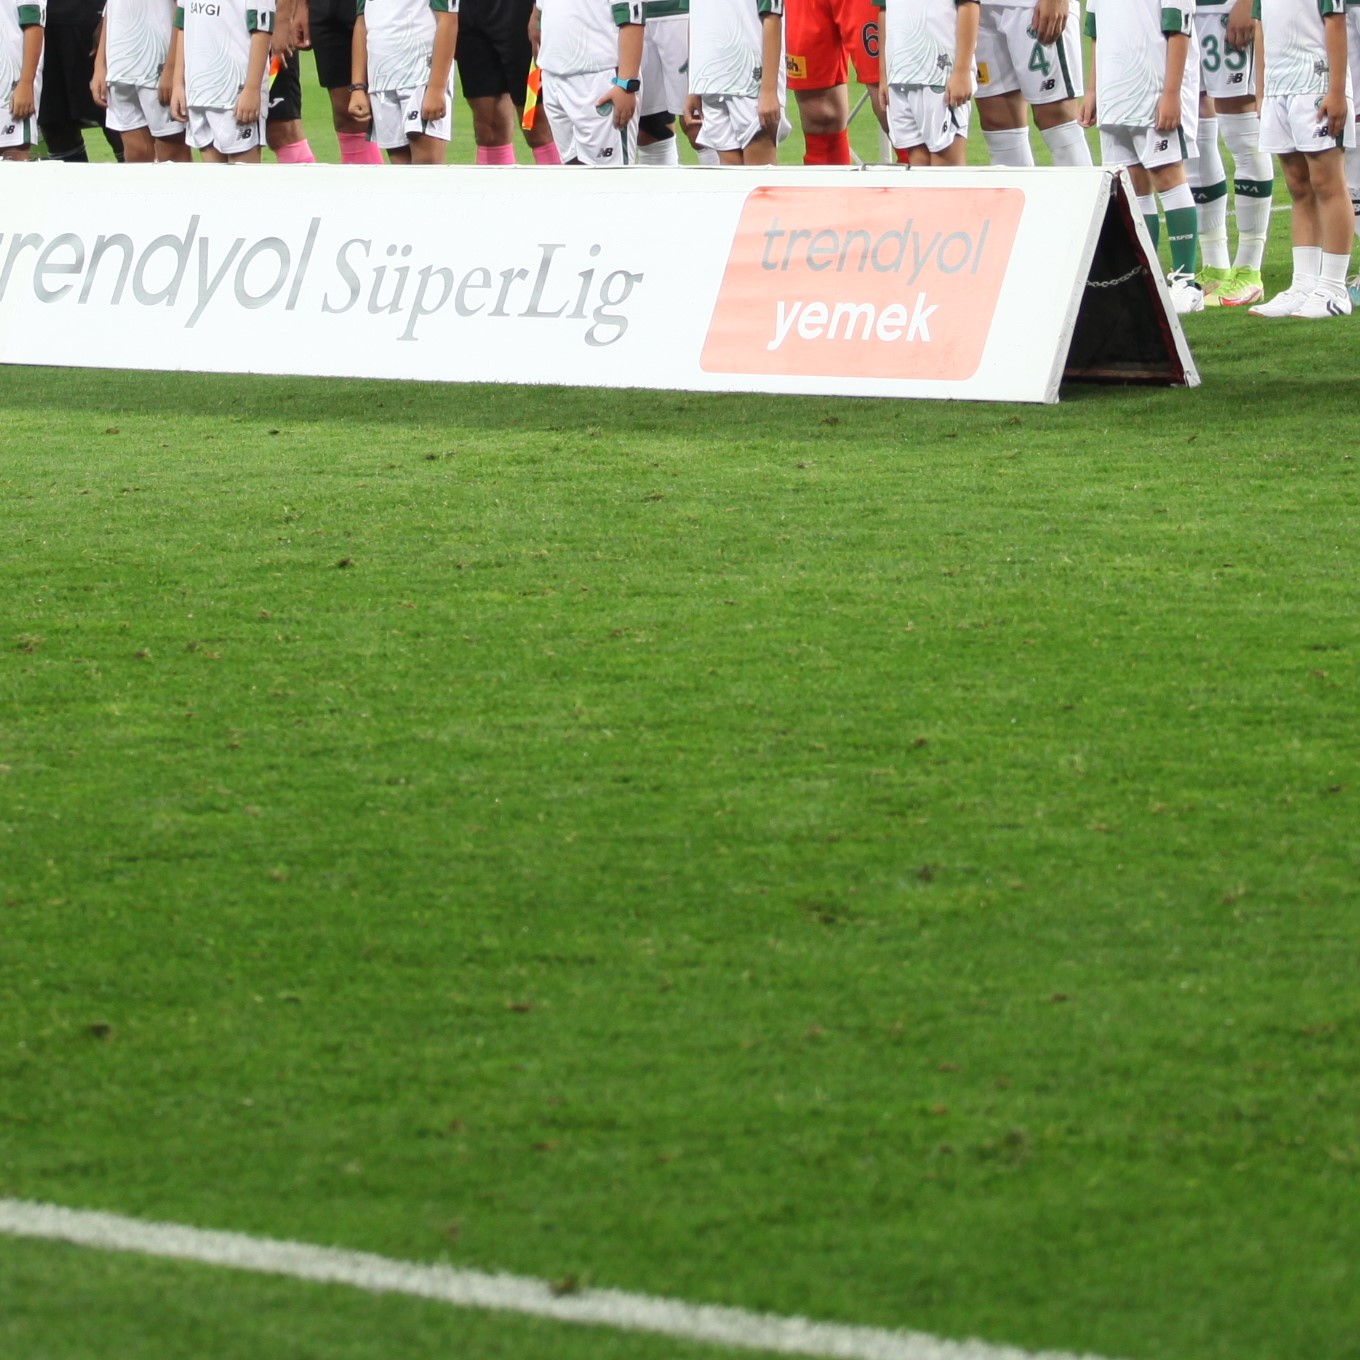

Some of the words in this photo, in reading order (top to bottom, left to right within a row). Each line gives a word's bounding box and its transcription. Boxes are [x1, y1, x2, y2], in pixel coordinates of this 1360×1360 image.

[862, 22, 880, 59] 6
[1028, 39, 1051, 76] 4
[1202, 34, 1247, 72] 35
[761, 215, 992, 288] trendyol
[324, 236, 646, 348] SüperLig
[769, 291, 938, 354] yemek
